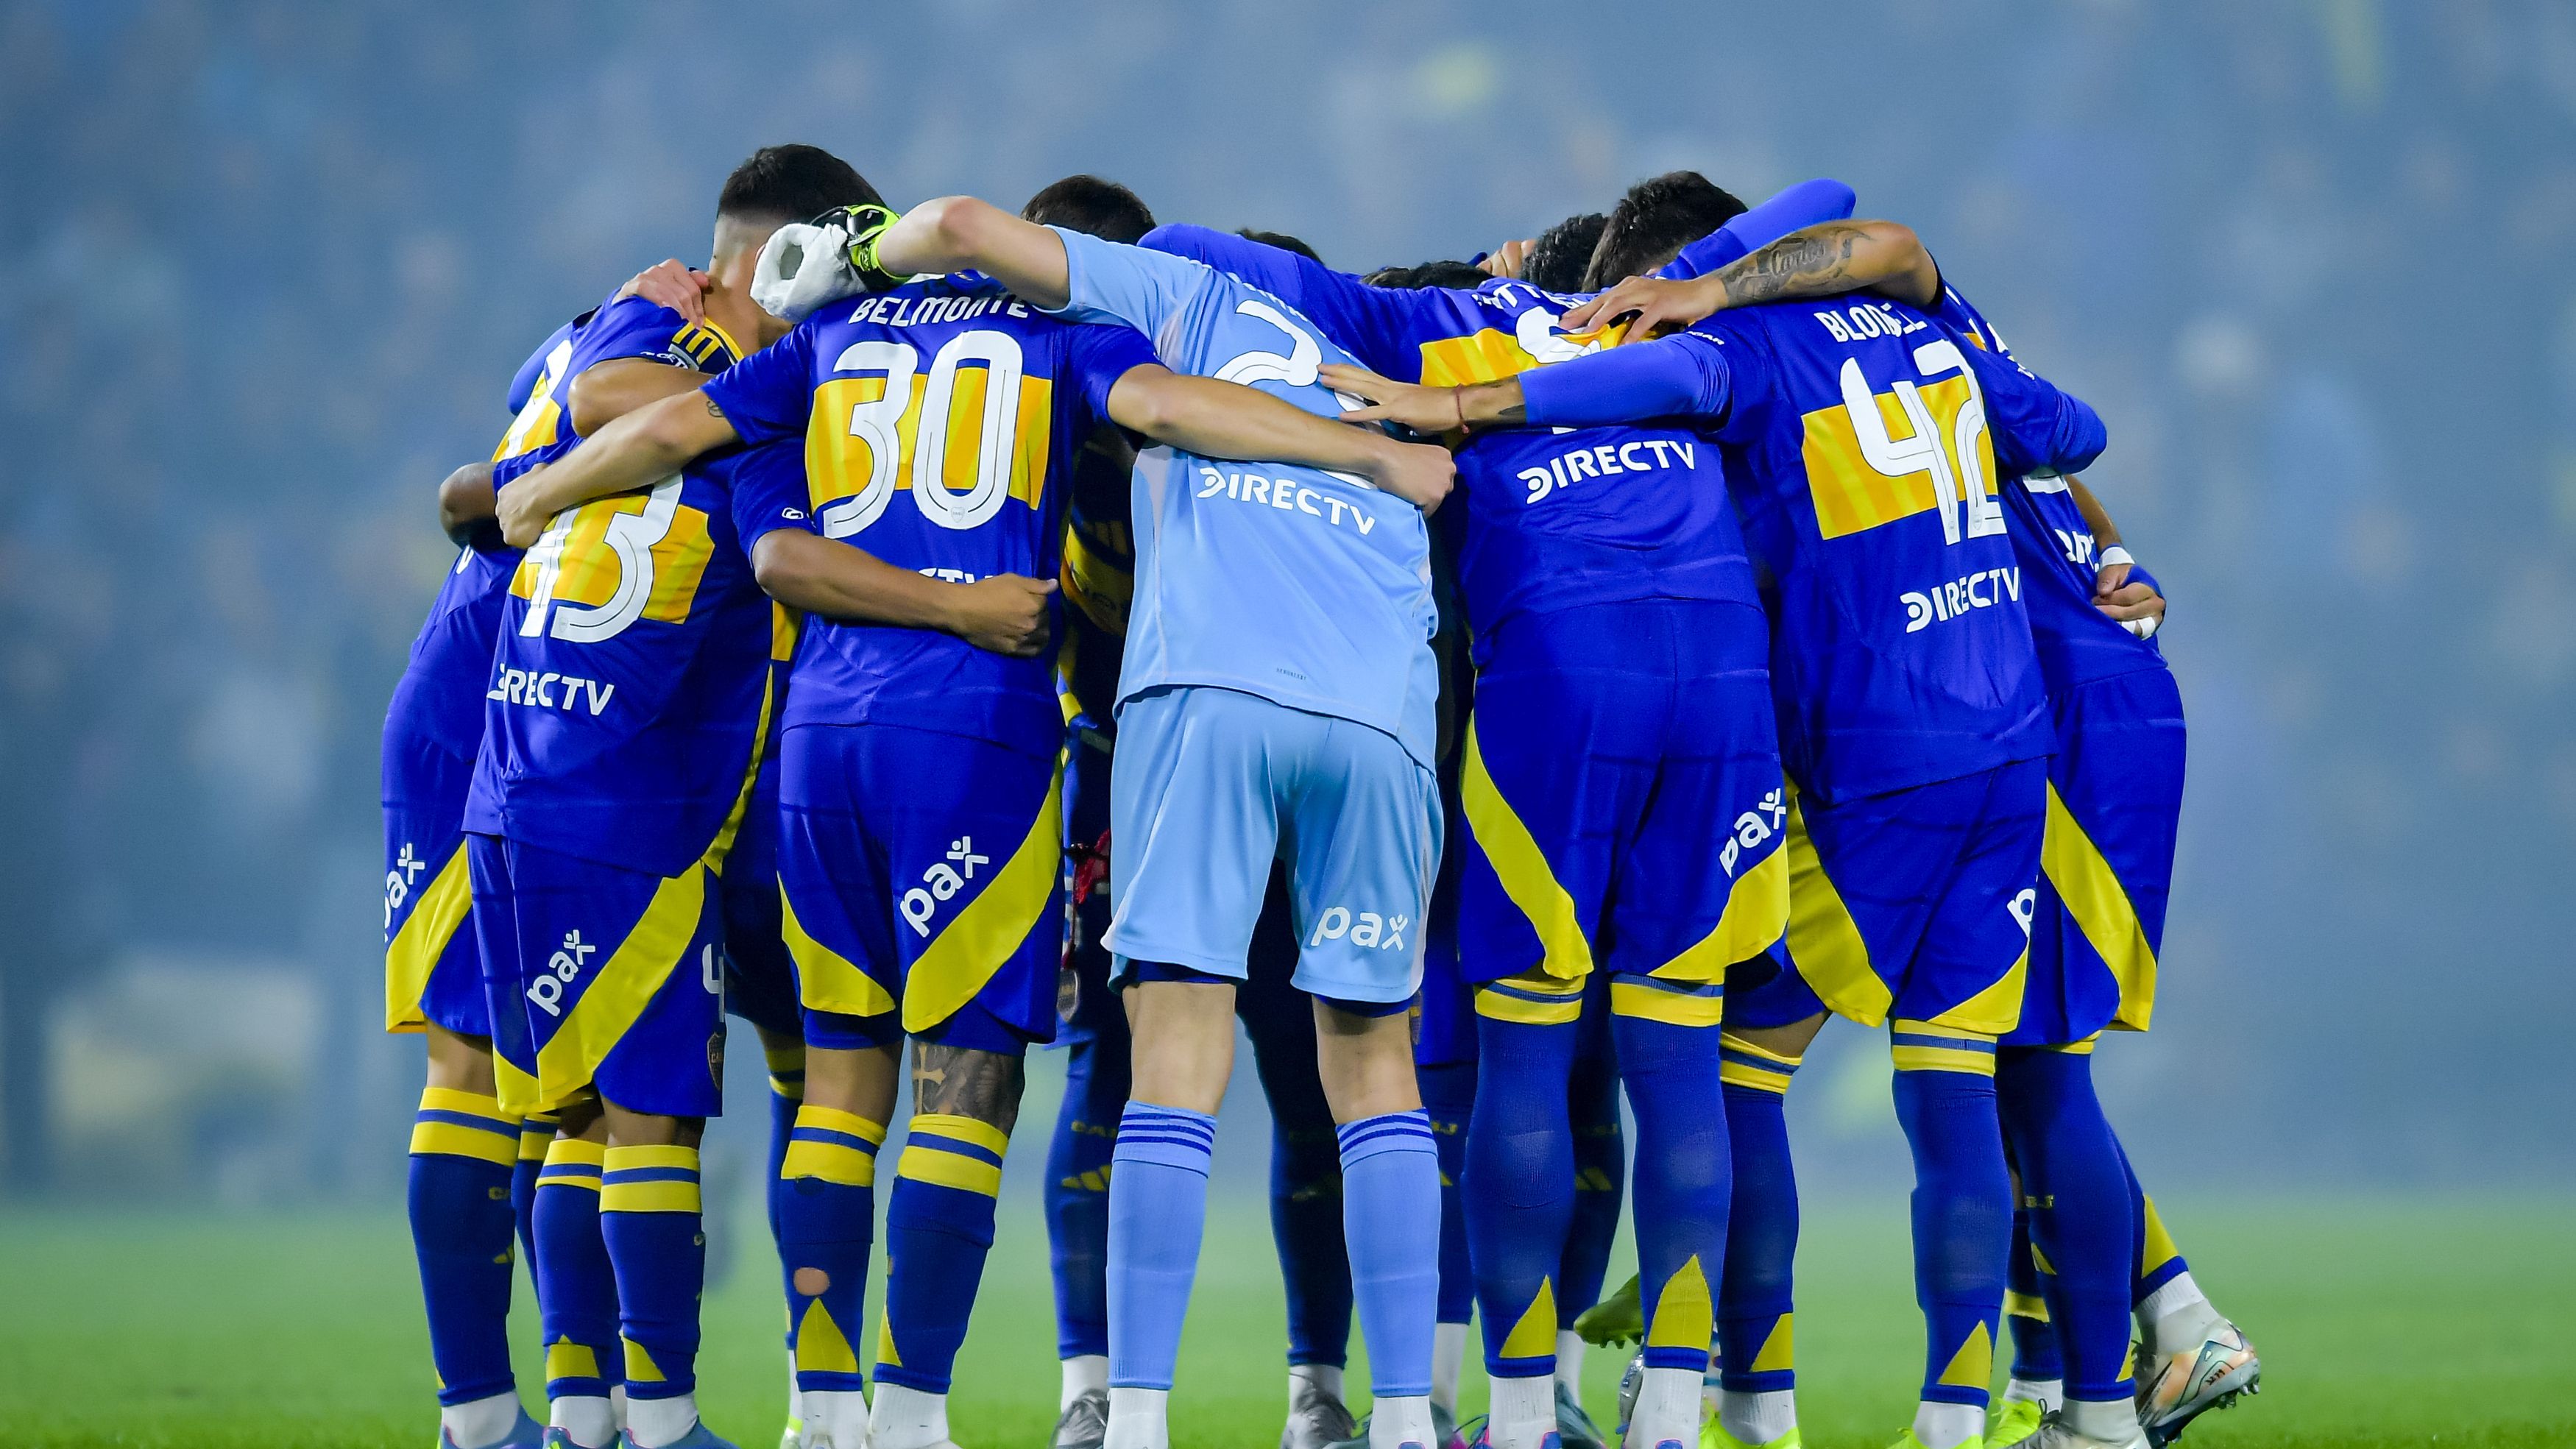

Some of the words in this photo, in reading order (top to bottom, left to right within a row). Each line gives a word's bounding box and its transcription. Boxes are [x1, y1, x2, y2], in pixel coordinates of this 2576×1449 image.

[848, 296, 1029, 327] BELMONTE
[822, 330, 1023, 539] 30
[1517, 441, 1695, 504] DIRECTV
[1839, 339, 2008, 545] 42
[1197, 467, 1376, 536] DIRECTV
[1900, 567, 2019, 633] DIRECTV
[1719, 787, 1786, 878] pax
[899, 836, 989, 938] pax
[1310, 906, 1409, 952] pax
[527, 929, 595, 1016] pax
